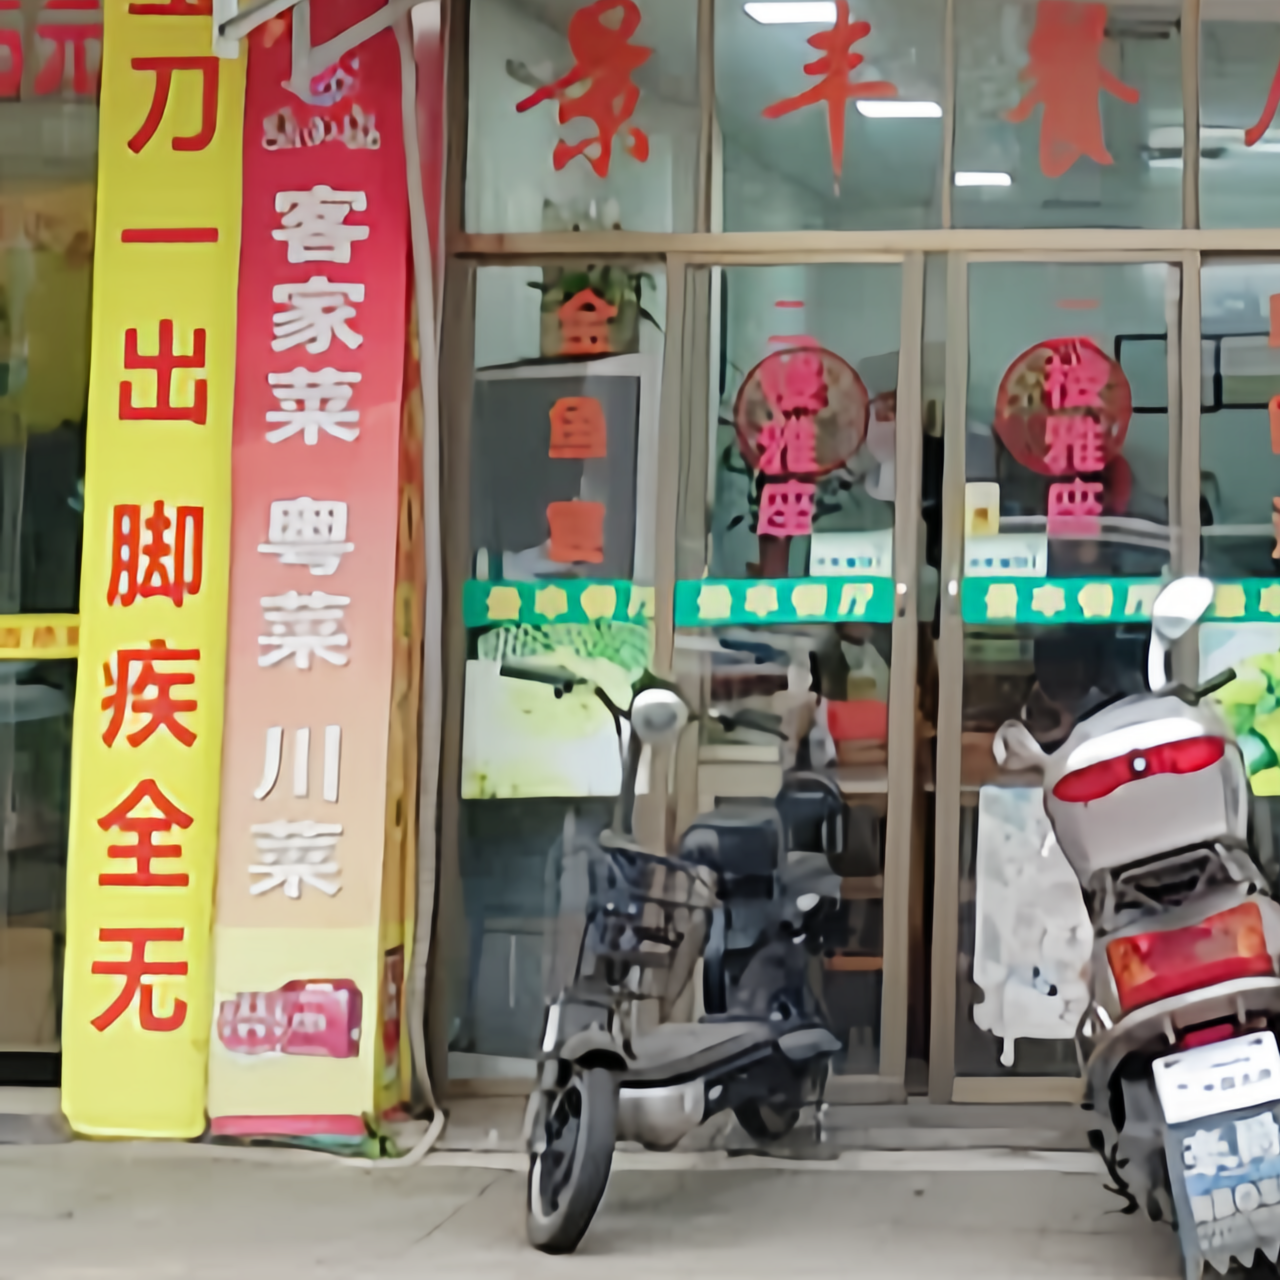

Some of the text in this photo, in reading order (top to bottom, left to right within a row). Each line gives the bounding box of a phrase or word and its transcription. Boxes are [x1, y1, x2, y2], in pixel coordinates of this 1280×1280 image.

[265, 184, 370, 445] 客家菜
[257, 496, 355, 670] 粤菜
[90, 499, 205, 1033] 脚疾全无
[247, 724, 343, 899] 川菜
